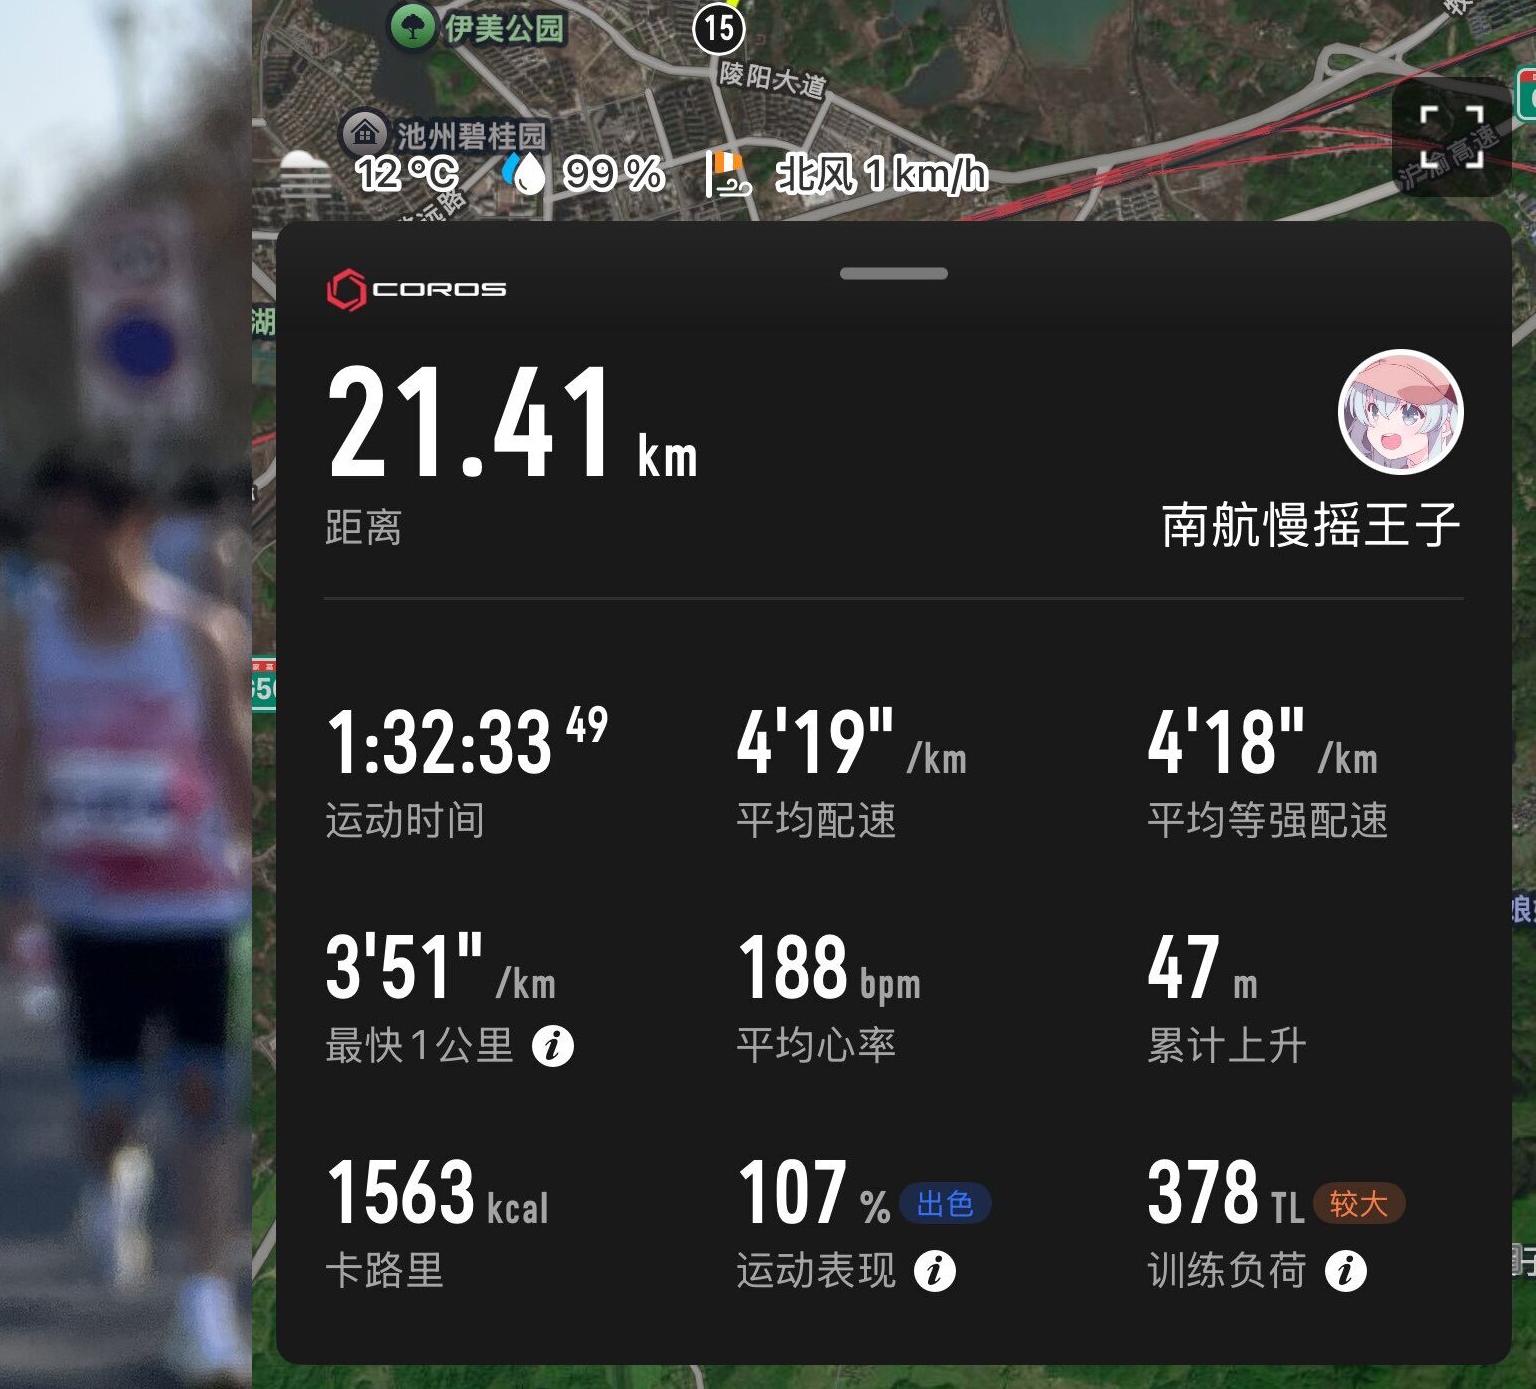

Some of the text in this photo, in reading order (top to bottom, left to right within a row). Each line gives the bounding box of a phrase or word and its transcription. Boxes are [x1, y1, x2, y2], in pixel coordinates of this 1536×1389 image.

[445, 14, 565, 46] 伊美公园
[703, 14, 733, 42] 15
[718, 60, 828, 101] 陵阳大道
[397, 122, 547, 153] 池州碧桂园
[354, 154, 459, 194] 12 °C
[562, 155, 666, 193] 99 %
[775, 152, 990, 198] 北风 1 km/h
[372, 281, 507, 297] COROS
[328, 364, 698, 478] 21.41 km
[324, 508, 402, 546] 距离
[1162, 500, 1462, 548] 南航慢摇王子
[327, 705, 609, 775] 1:32:33 49
[735, 705, 967, 775] 4'19" /km
[1147, 705, 1379, 775] 4'18" /km
[324, 800, 485, 839] 运动时间
[735, 800, 896, 839] 平均配速
[1147, 800, 1389, 839] 平均等强配速
[325, 931, 556, 1000] 3'51" /km
[739, 933, 921, 1007] 188 bpm
[1147, 933, 1258, 999] 47 m
[324, 1025, 514, 1065] 最快1公里
[735, 1025, 896, 1064] 平均心率
[1147, 1025, 1307, 1064] 累计上升
[327, 1157, 549, 1225] 1563 kcal
[739, 1157, 891, 1225] 107 %
[916, 1189, 975, 1219] 出色
[1147, 1157, 1306, 1225] 378 TL
[1329, 1189, 1389, 1219] 较大
[324, 1251, 444, 1289] 卡路里
[735, 1251, 896, 1289] 运动表现
[1147, 1251, 1307, 1289] 训练负荷
